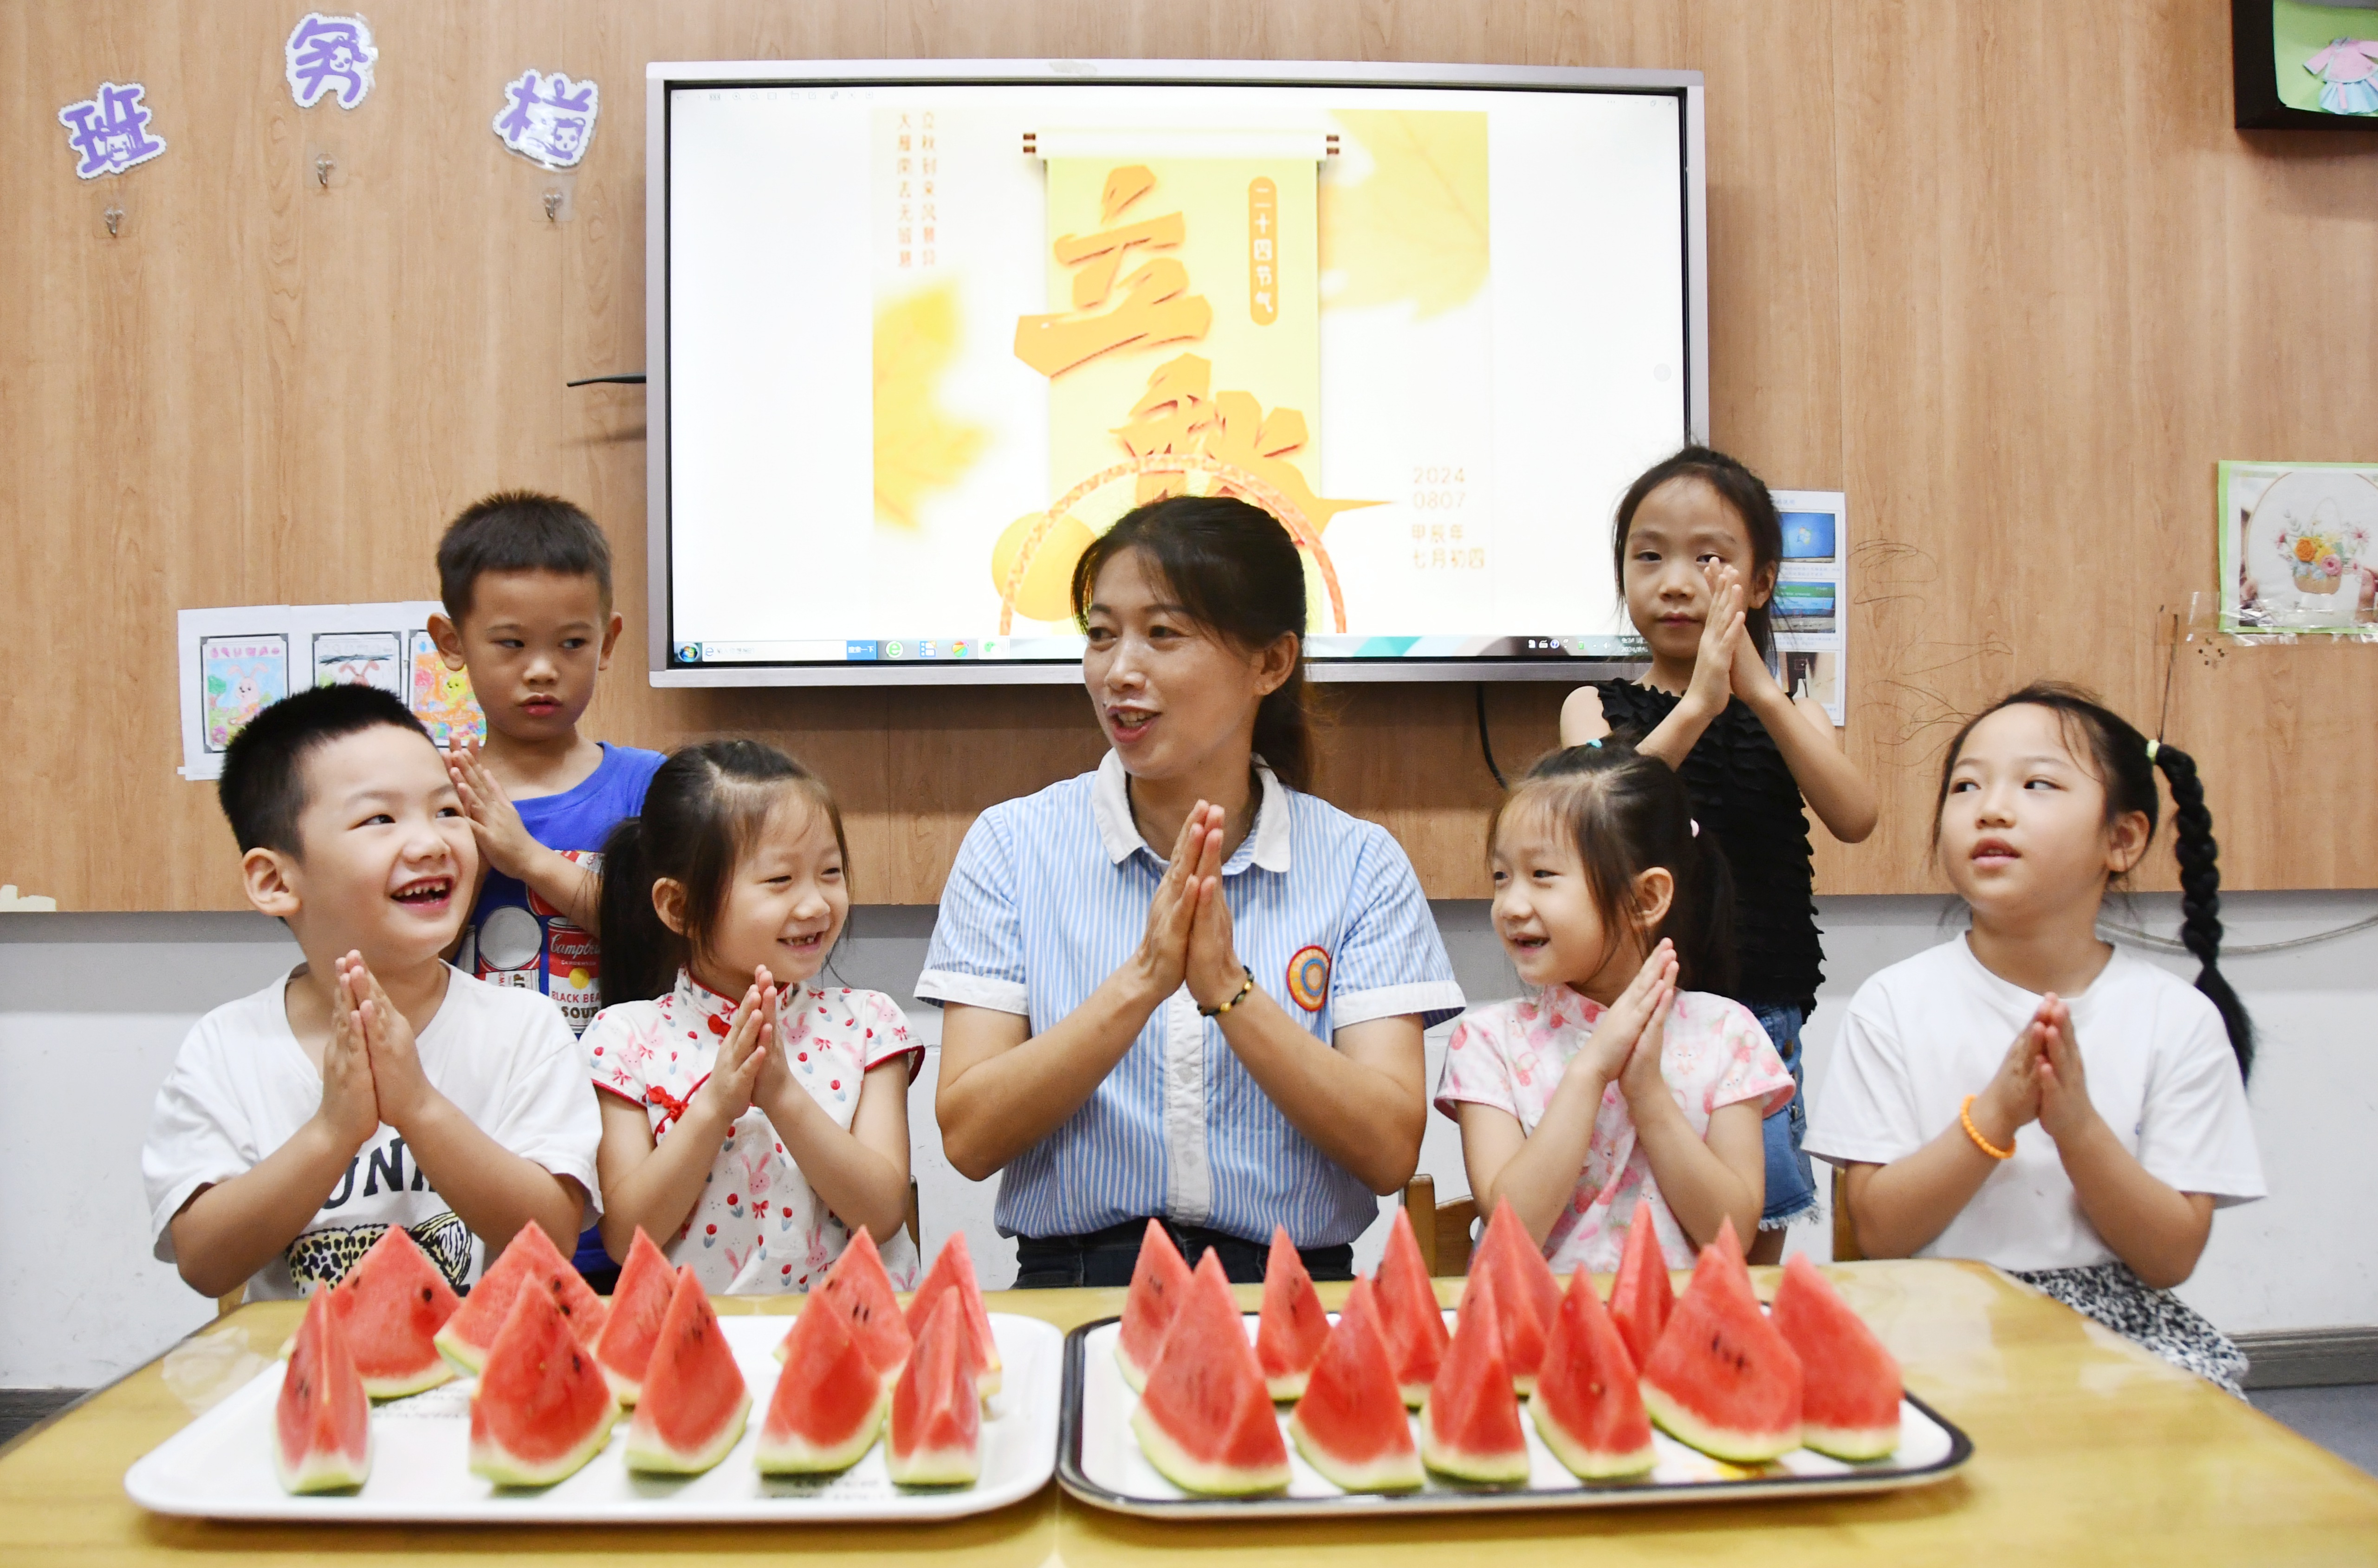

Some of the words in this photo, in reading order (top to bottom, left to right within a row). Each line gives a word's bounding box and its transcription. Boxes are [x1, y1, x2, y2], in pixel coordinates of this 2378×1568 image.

[64, 86, 159, 173] 班
[293, 18, 368, 100] 务
[1253, 187, 1274, 314] 二十四节气
[1414, 467, 1464, 483] 2024
[1413, 491, 1466, 509] 0807
[1413, 547, 1485, 569] 七月初四
[551, 991, 579, 1003] BLACK
[561, 1006, 599, 1019] SOUP
